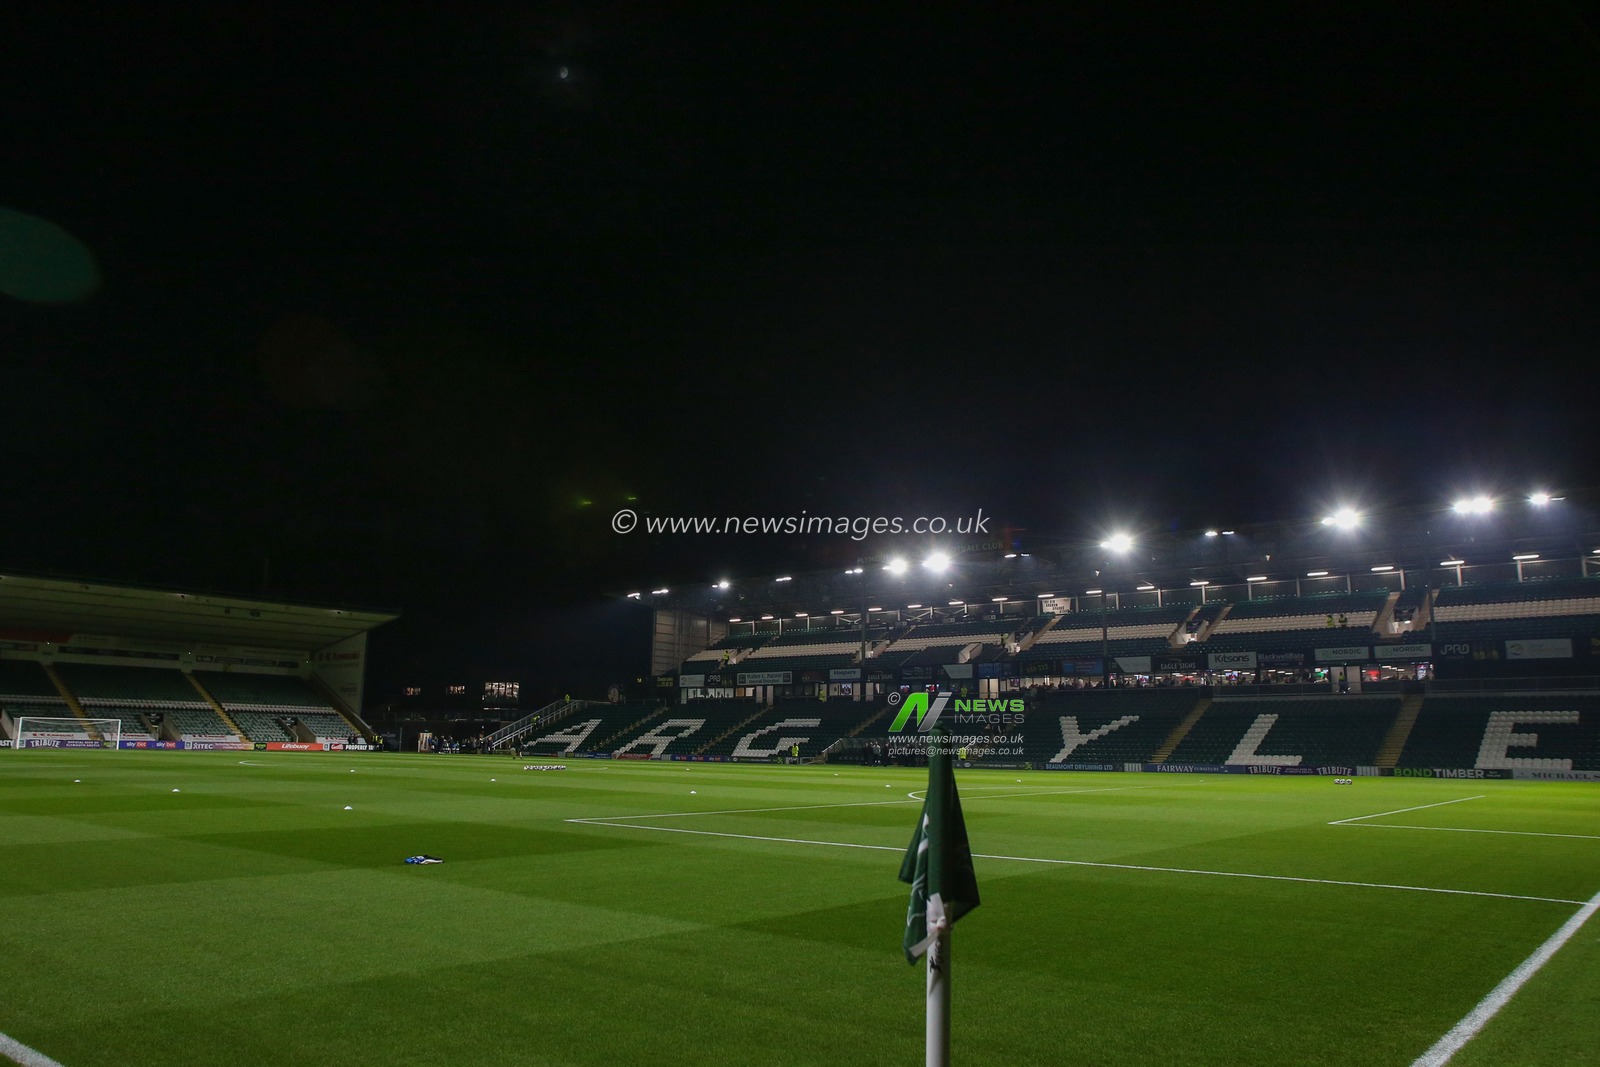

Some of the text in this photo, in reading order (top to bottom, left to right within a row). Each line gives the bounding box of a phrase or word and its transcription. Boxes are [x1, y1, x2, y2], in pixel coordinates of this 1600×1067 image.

[1393, 645, 1424, 653] NORDIC
[1214, 654, 1250, 663] Kitsons
[30, 739, 61, 748] TRIBUTE
[1157, 764, 1194, 772] FAIRWAY
[1248, 765, 1282, 775] TRIBUTE
[1316, 766, 1352, 776] TRIBUTE
[1532, 772, 1591, 780] MICHAEL
